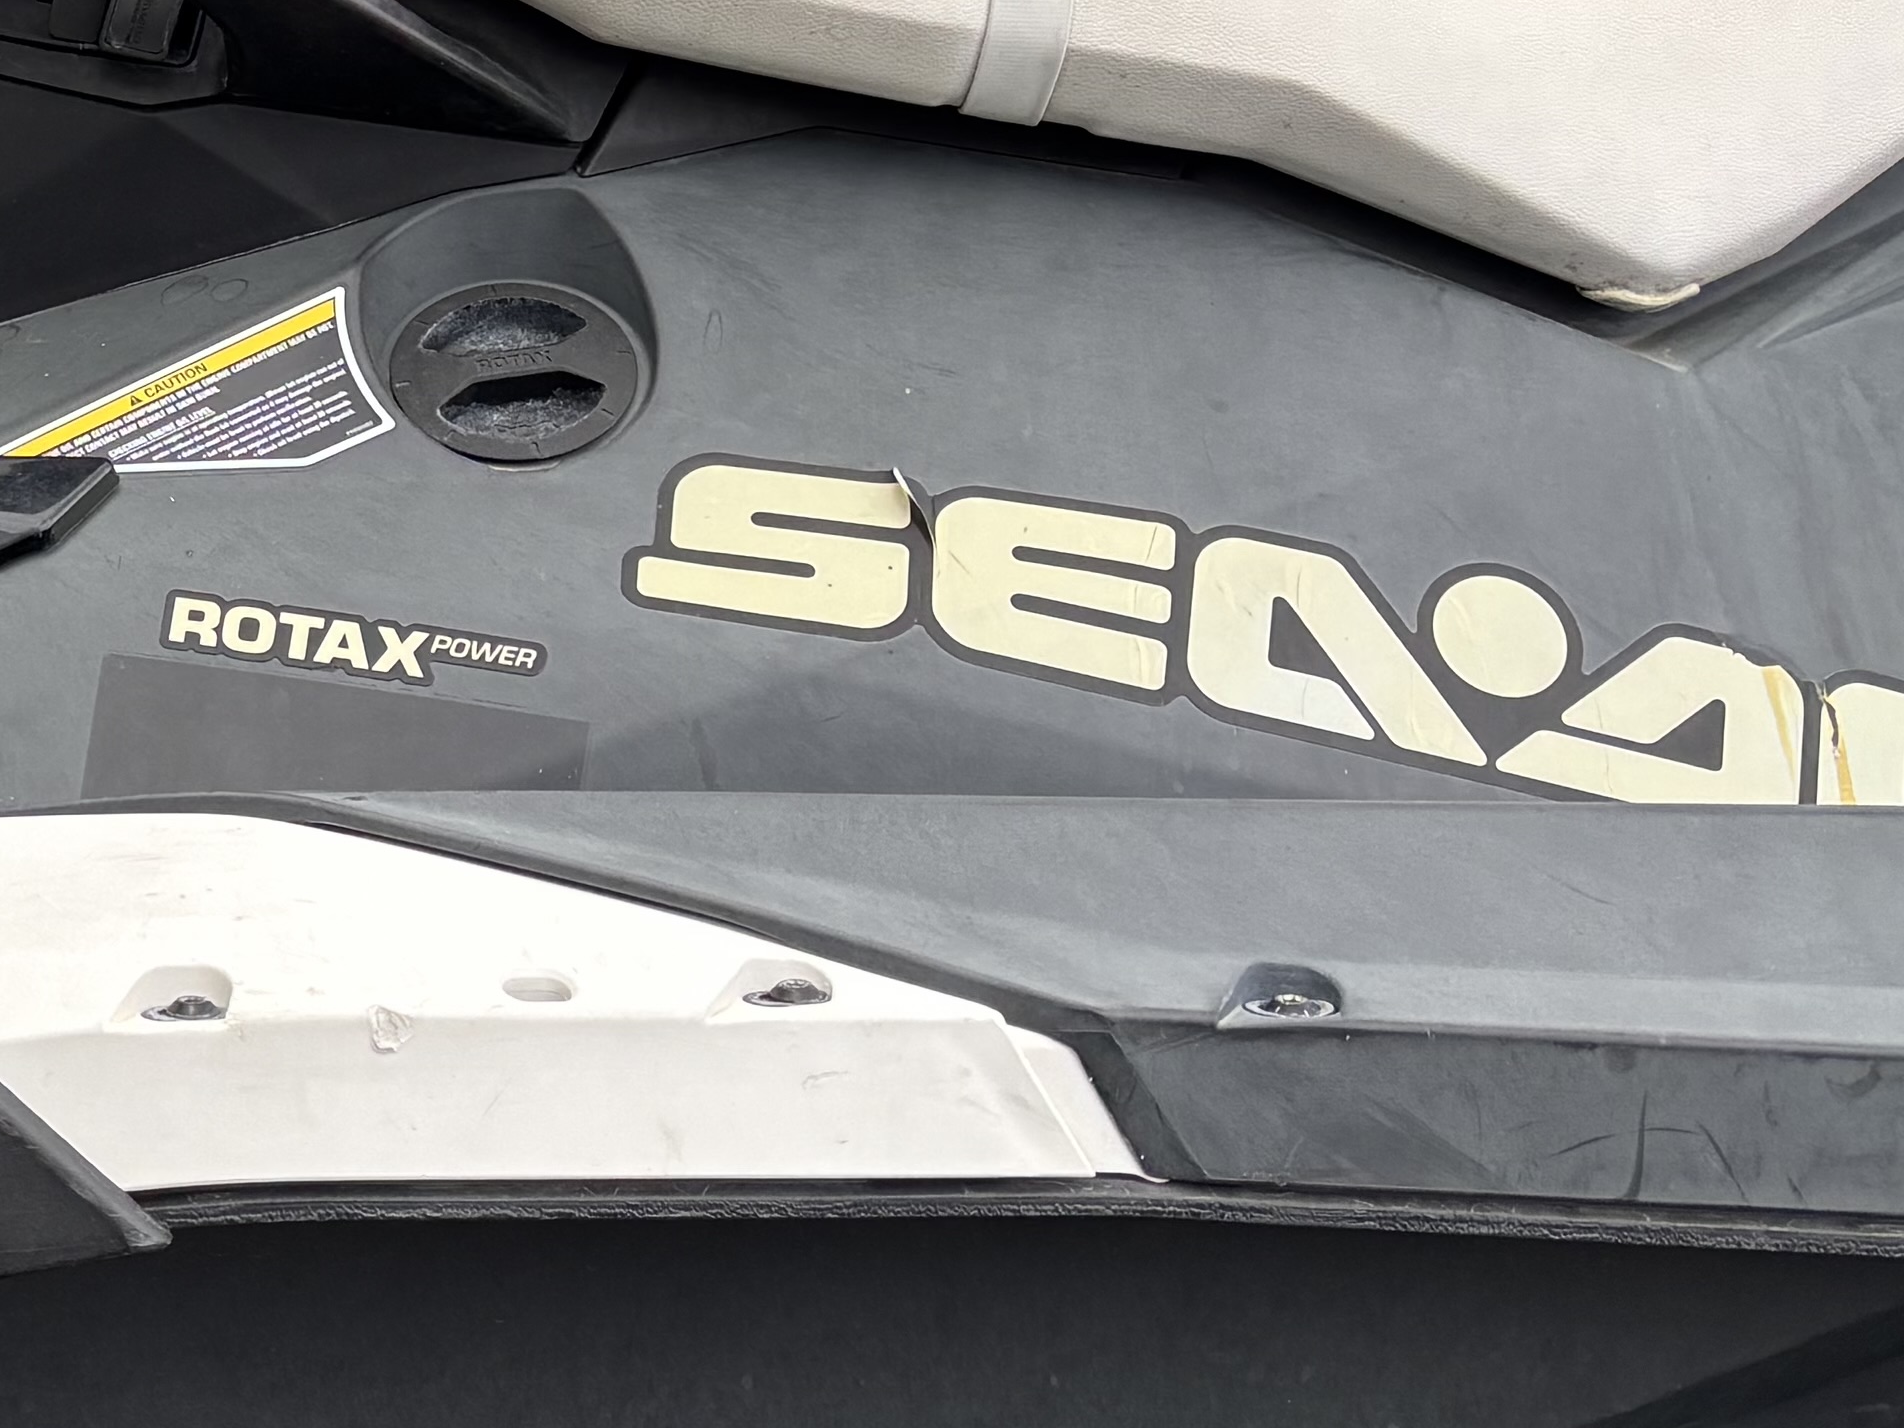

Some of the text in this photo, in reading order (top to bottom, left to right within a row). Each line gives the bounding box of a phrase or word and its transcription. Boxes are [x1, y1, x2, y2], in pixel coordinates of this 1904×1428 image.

[476, 350, 553, 370] ROTAX
[144, 363, 208, 399] CAUTION
[169, 597, 538, 678] ROTAX POWER
